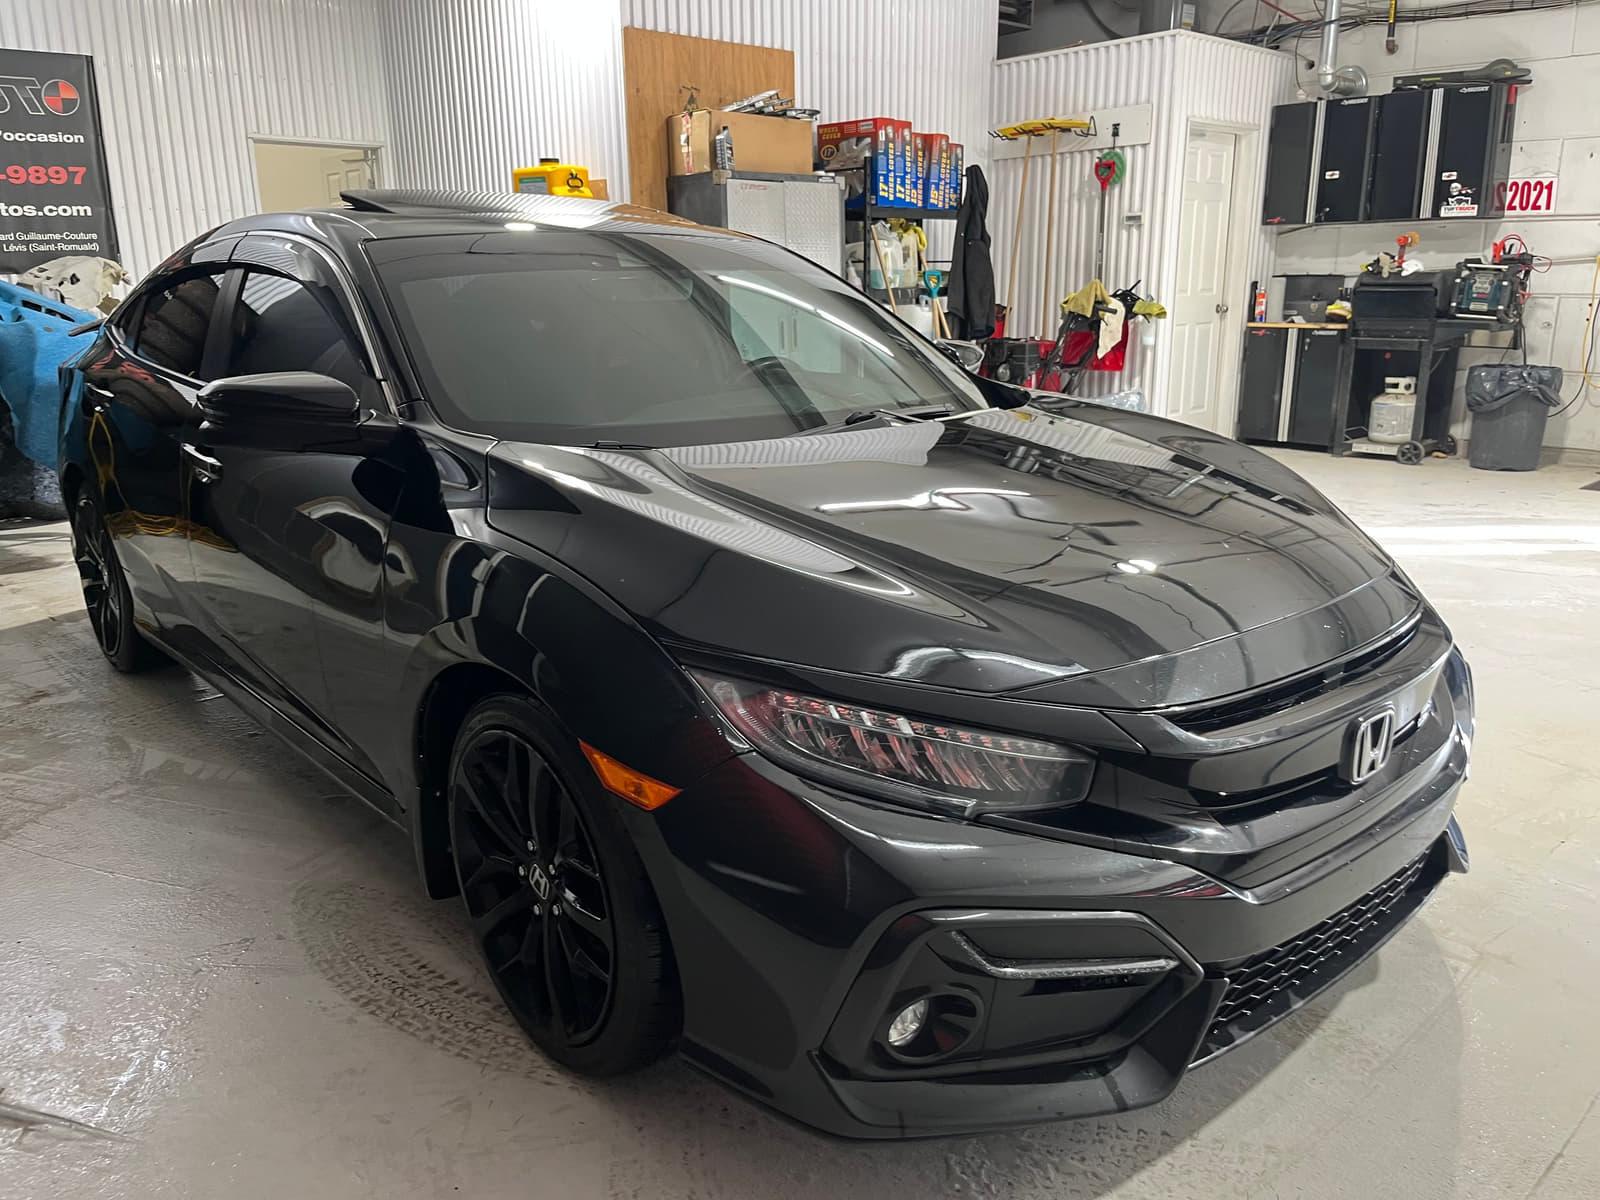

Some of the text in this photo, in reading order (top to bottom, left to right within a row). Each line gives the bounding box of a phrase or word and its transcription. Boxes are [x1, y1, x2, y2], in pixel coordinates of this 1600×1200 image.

[939, 151, 947, 179] COVER
[879, 176, 888, 197] 17"
[896, 178, 904, 199] 17"
[1506, 180, 1554, 212] 2021
[16, 232, 98, 240] Guillaume-Couture
[3, 242, 100, 253] Lévis (Saint-Romuald)
